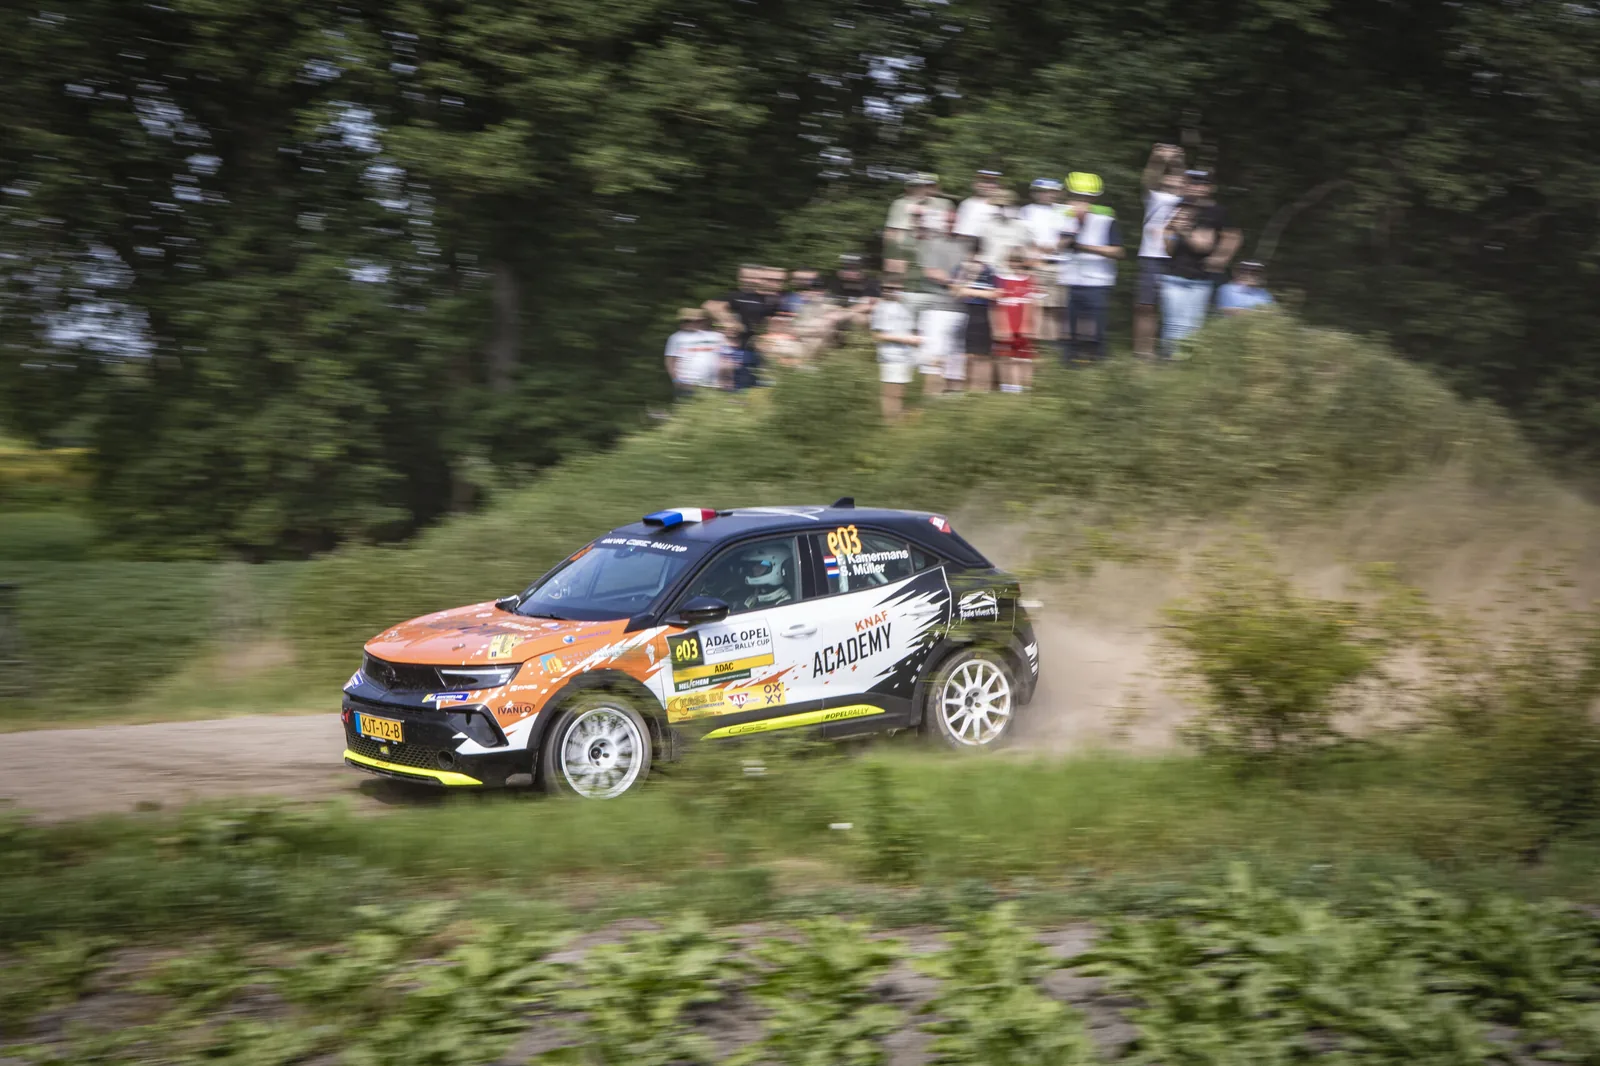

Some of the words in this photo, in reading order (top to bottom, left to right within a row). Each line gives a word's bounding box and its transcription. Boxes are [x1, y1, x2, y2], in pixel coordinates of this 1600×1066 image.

[827, 524, 862, 556] e03
[848, 549, 909, 565] Kamermans
[853, 563, 886, 577] Müller
[855, 610, 888, 633] KNAF
[705, 632, 738, 648] ADAC
[740, 627, 769, 641] OPEL
[756, 639, 770, 647] CUP
[675, 638, 698, 662] e03
[813, 622, 892, 679] ACADEMY
[714, 662, 734, 674] ADAC
[732, 694, 748, 706] AD
[497, 705, 532, 715] IVANLO
[825, 707, 869, 720] #OPELRALLY
[361, 717, 400, 739] KJT-12-B
